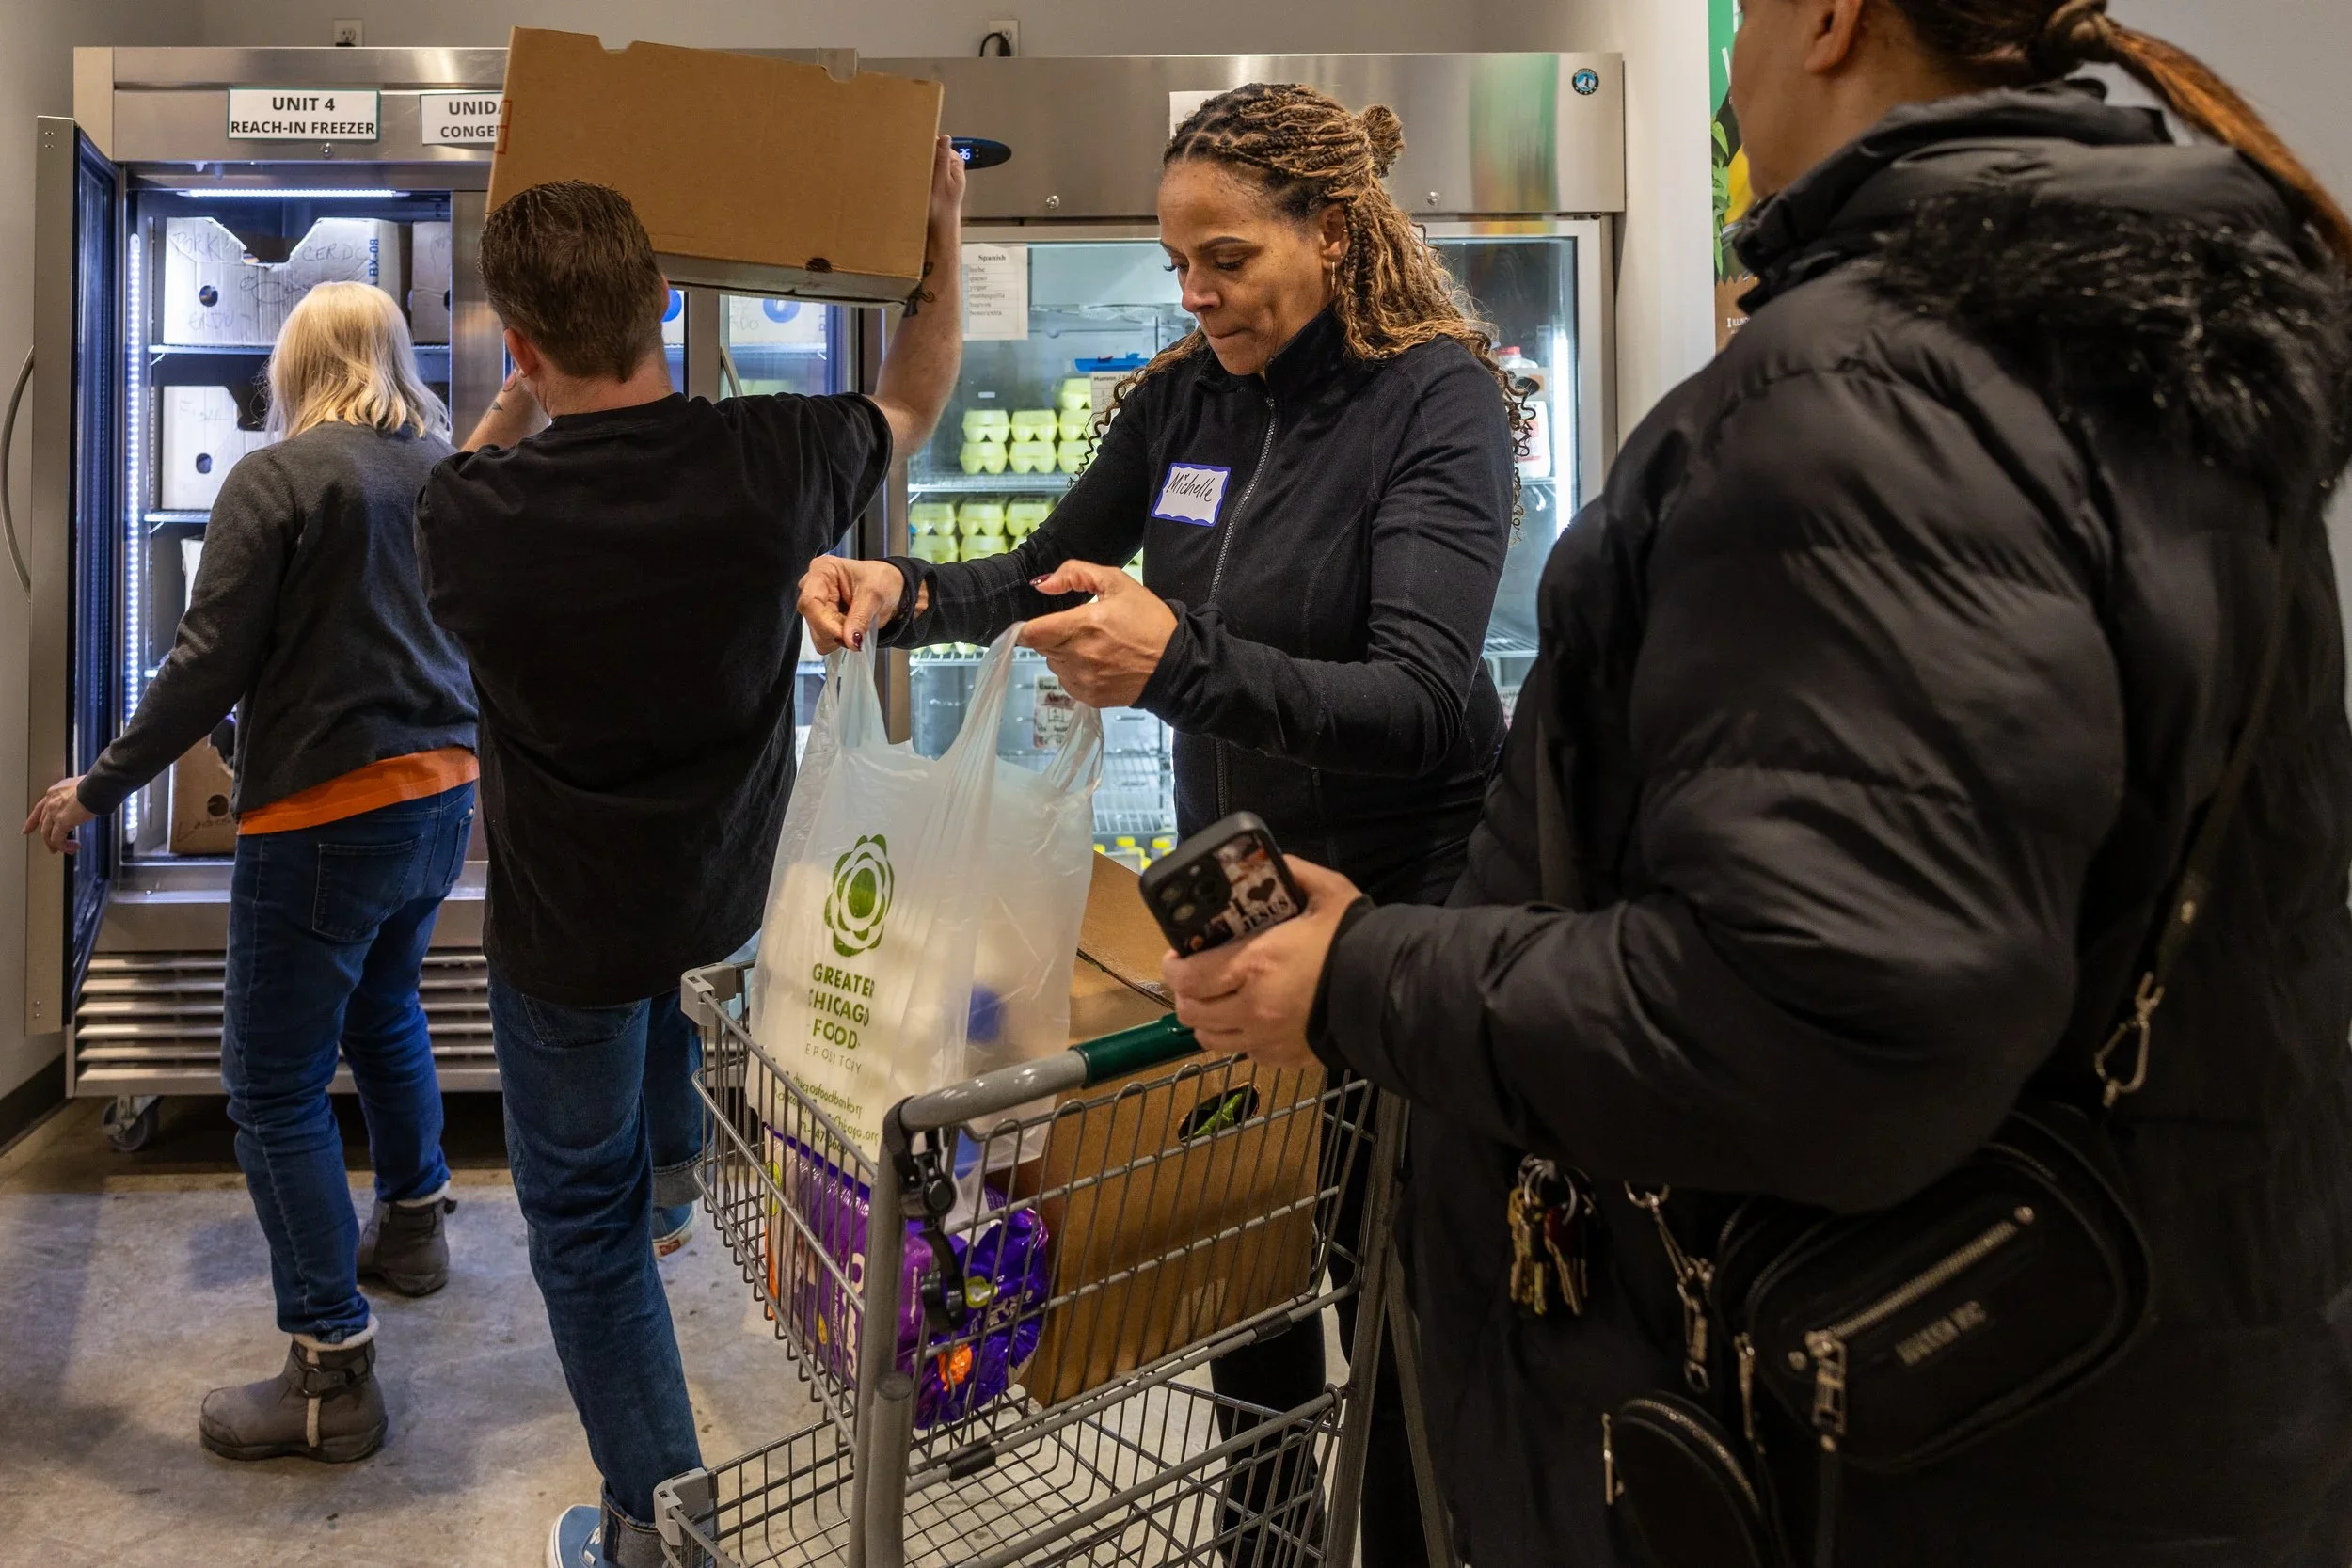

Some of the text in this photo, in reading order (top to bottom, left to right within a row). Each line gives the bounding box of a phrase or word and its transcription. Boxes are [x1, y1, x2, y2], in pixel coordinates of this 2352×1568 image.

[272, 97, 336, 111] UNIT 4
[230, 120, 375, 135] REACH-IN FREEZER
[368, 238, 379, 277] BX-08
[977, 253, 1007, 262] Spanish
[1166, 472, 1216, 502] Michelle
[812, 962, 876, 999] GREATER
[812, 1017, 859, 1050] FOOD
